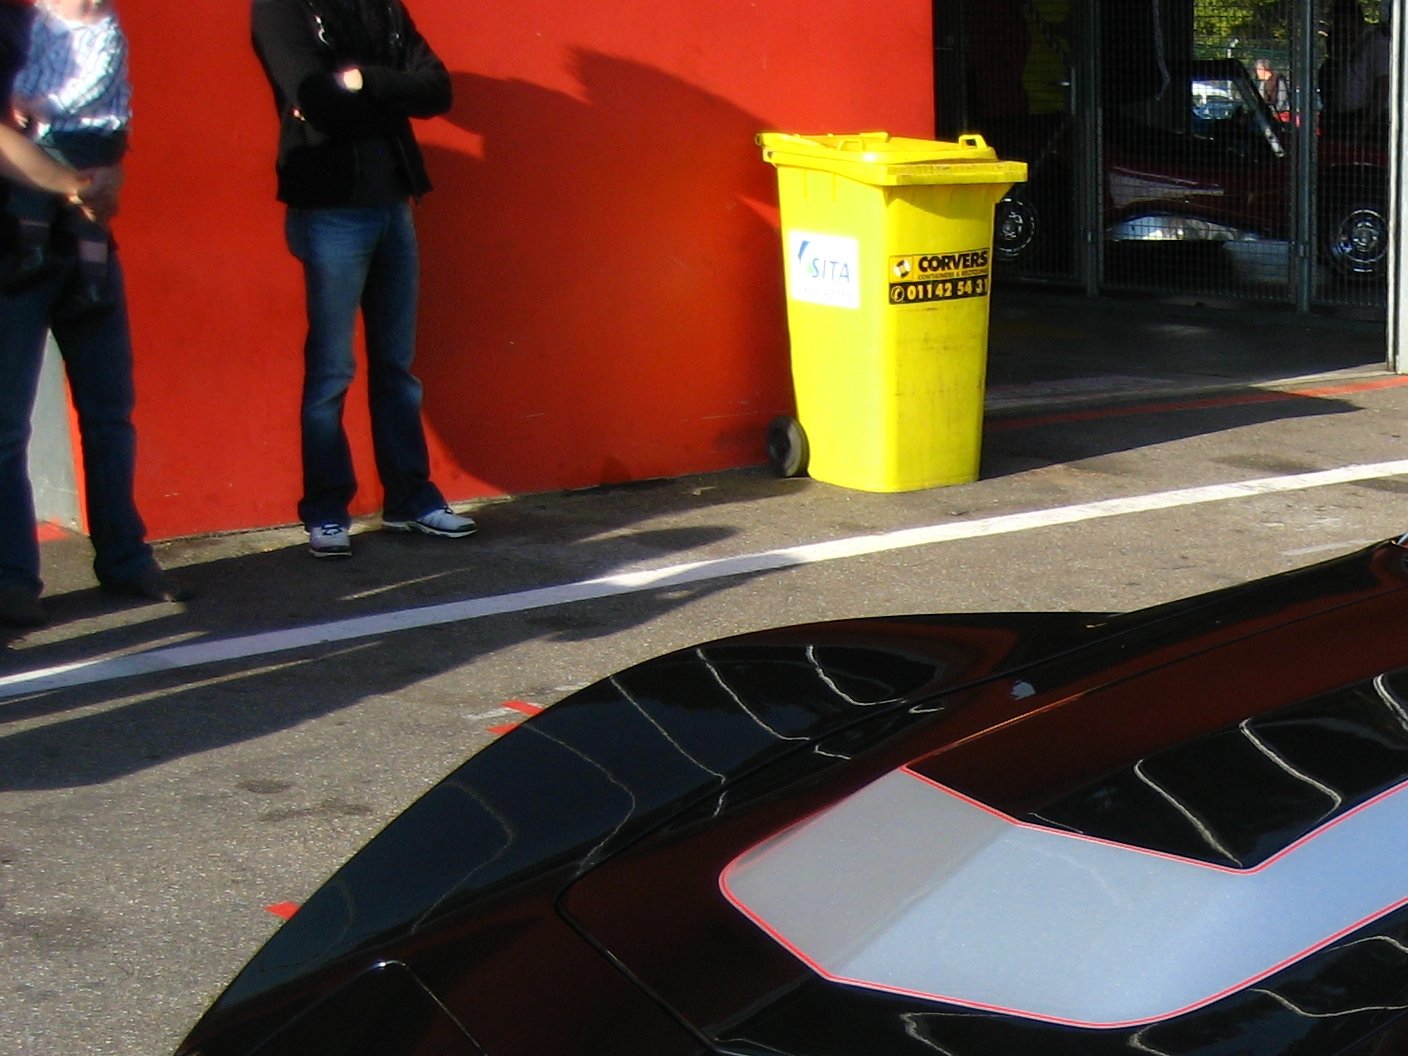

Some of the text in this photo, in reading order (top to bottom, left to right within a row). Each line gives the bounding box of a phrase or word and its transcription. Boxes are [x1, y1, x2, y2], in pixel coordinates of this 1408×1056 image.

[811, 257, 850, 284] SITA
[918, 251, 988, 272] CORVERS
[957, 280, 973, 295] 54
